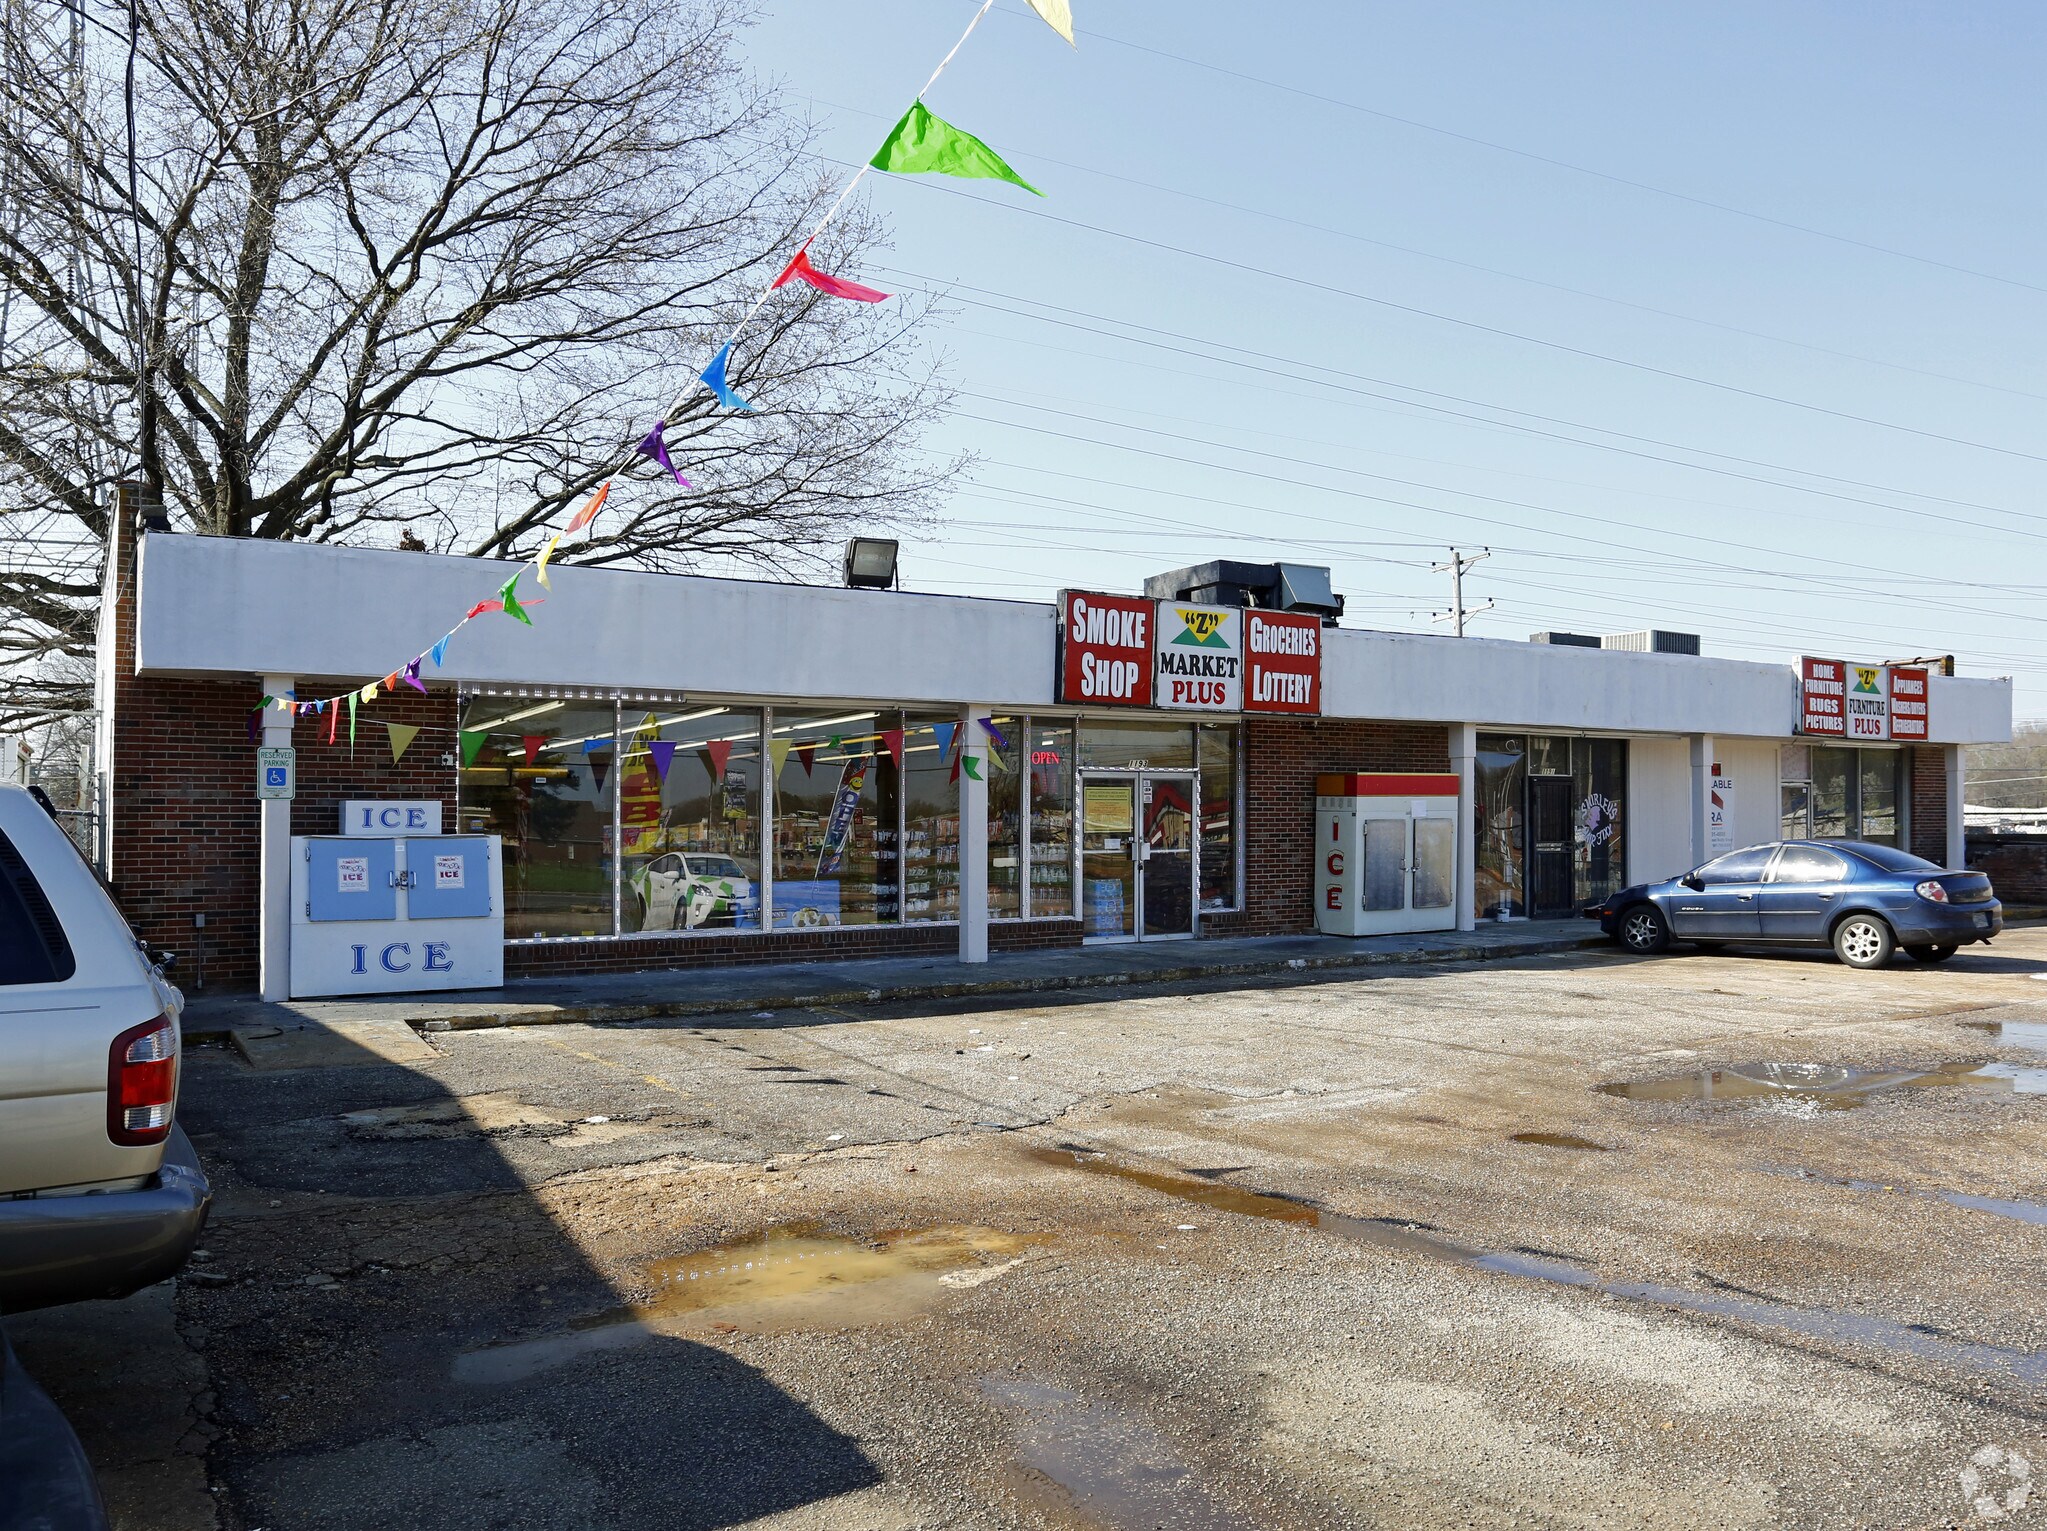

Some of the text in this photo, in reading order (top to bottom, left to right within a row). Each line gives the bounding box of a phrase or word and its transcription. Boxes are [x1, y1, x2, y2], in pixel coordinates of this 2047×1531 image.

[1073, 598, 1146, 648] SMOKE
[1250, 616, 1316, 656] GROCERIES
[1160, 652, 1238, 678] MARKET
[1813, 663, 1835, 680] HOME
[1081, 651, 1139, 698] SHOP
[1172, 680, 1226, 704] PLUS
[1252, 664, 1312, 704] LOTTERY
[1805, 679, 1843, 696] FURNITURE
[1809, 697, 1839, 714] RUGS
[1849, 699, 1885, 716] FURNITURE
[1805, 714, 1843, 731] PICTURES
[1854, 718, 1881, 735] PLUS
[261, 751, 292, 759] RESERVED
[1031, 751, 1060, 765] OPEN
[1129, 760, 1148, 768] 1193
[362, 807, 427, 829] ICE
[343, 873, 363, 881] ICE
[440, 870, 459, 878] ICE
[351, 941, 454, 975] ICE
